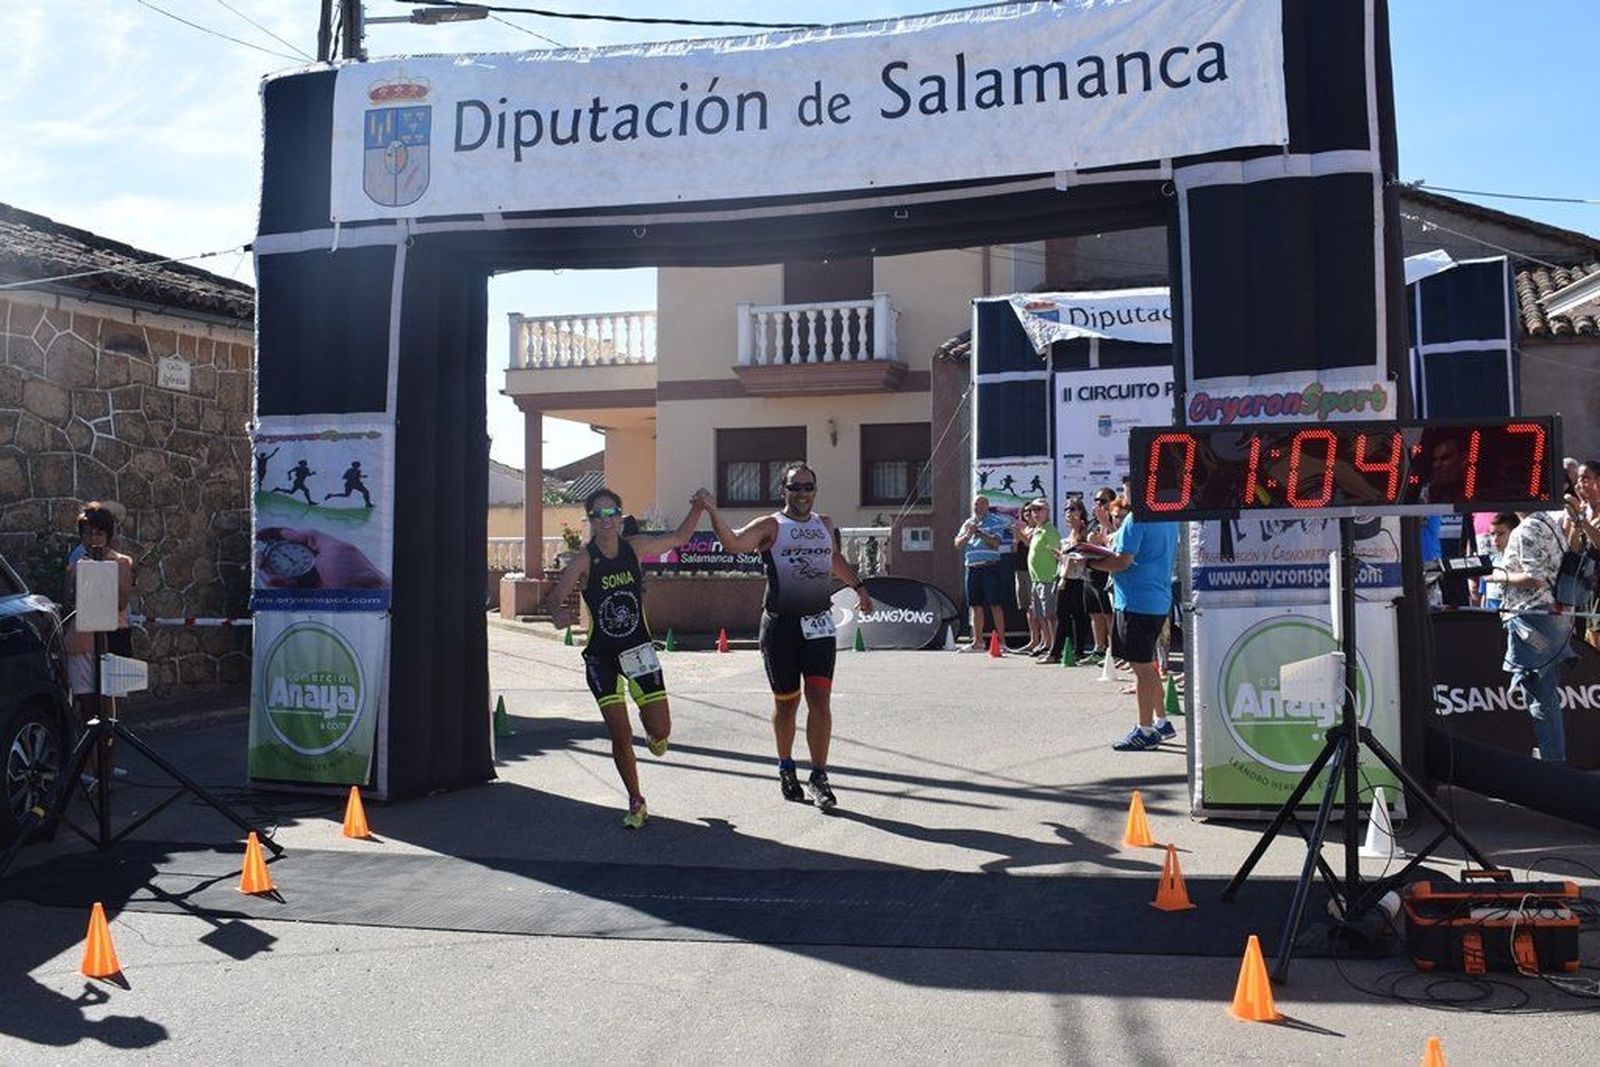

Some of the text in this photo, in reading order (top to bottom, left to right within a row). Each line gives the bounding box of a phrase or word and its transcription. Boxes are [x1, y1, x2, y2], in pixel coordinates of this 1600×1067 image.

[454, 40, 1229, 162] Diputación de Salamanca
[1069, 305, 1173, 331] Diputac
[1063, 387, 1072, 402] II
[1078, 383, 1160, 401] CIRCUITO
[790, 527, 826, 540] CASAS
[680, 552, 734, 564] Salamanca
[601, 571, 635, 590] SONIA
[268, 677, 356, 719] Anaya
